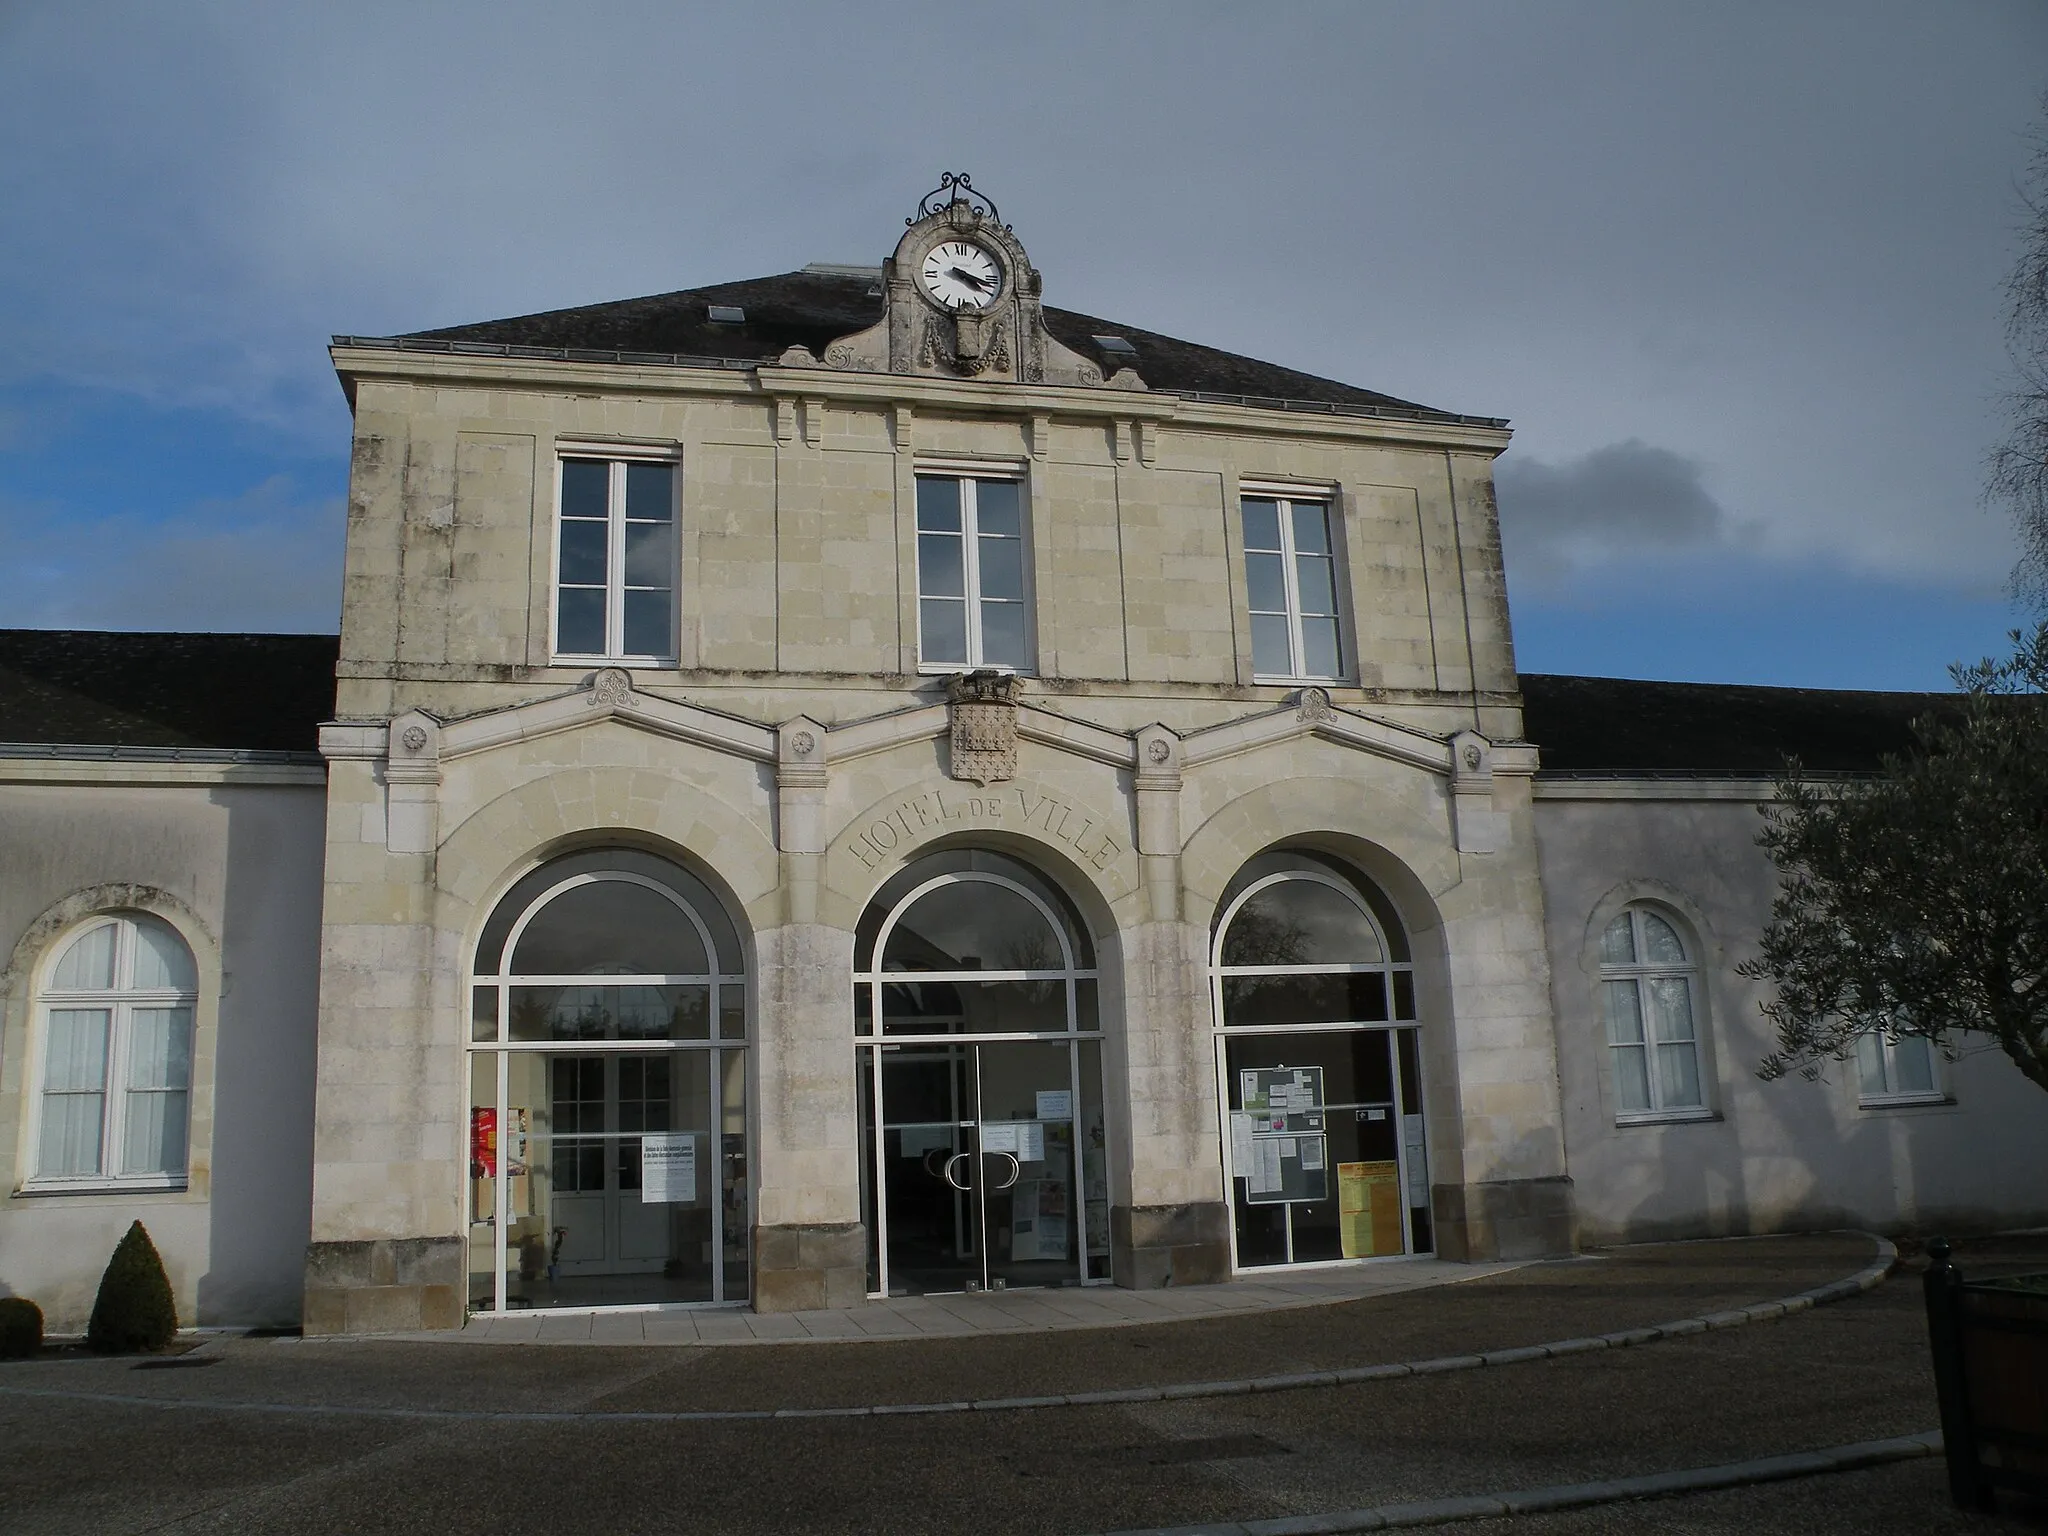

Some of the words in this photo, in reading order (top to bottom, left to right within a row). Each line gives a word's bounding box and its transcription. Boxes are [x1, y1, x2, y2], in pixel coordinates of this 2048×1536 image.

[954, 244, 967, 255] XII
[847, 790, 961, 873] HOTEL
[969, 797, 1002, 818] DE
[1014, 788, 1121, 873] VILLE
